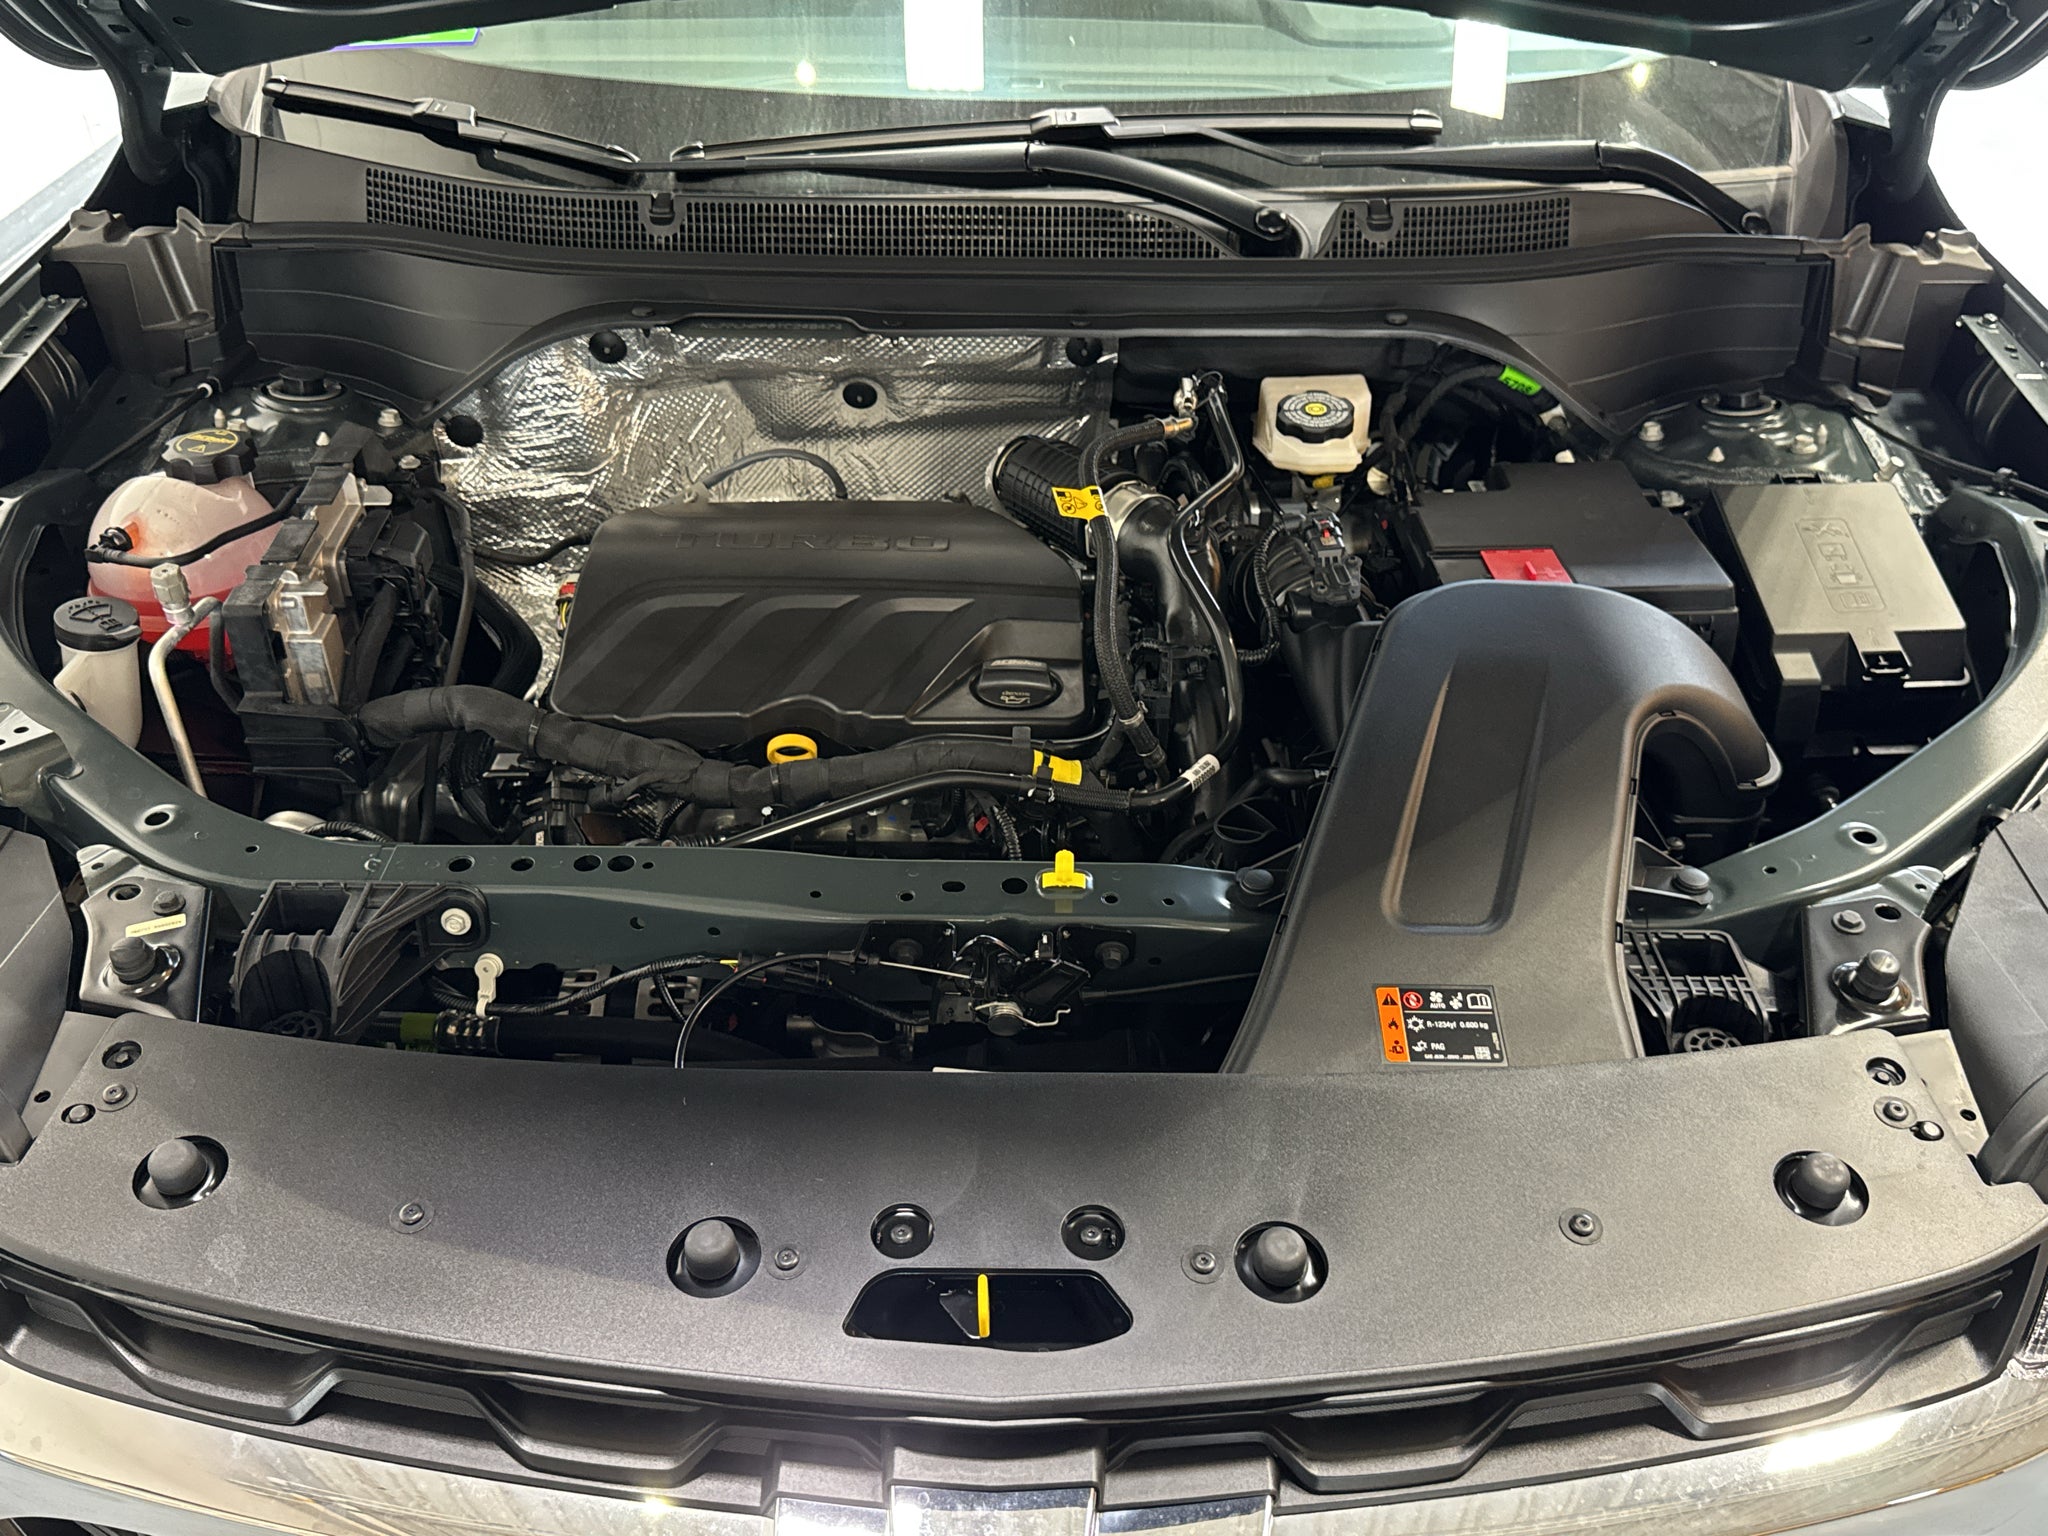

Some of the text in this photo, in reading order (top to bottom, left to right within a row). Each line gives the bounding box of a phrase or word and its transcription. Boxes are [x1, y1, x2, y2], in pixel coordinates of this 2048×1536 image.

[660, 532, 950, 552] TURBO
[1426, 1021, 1457, 1030] R-1234yf
[1479, 1021, 1489, 1030] kg
